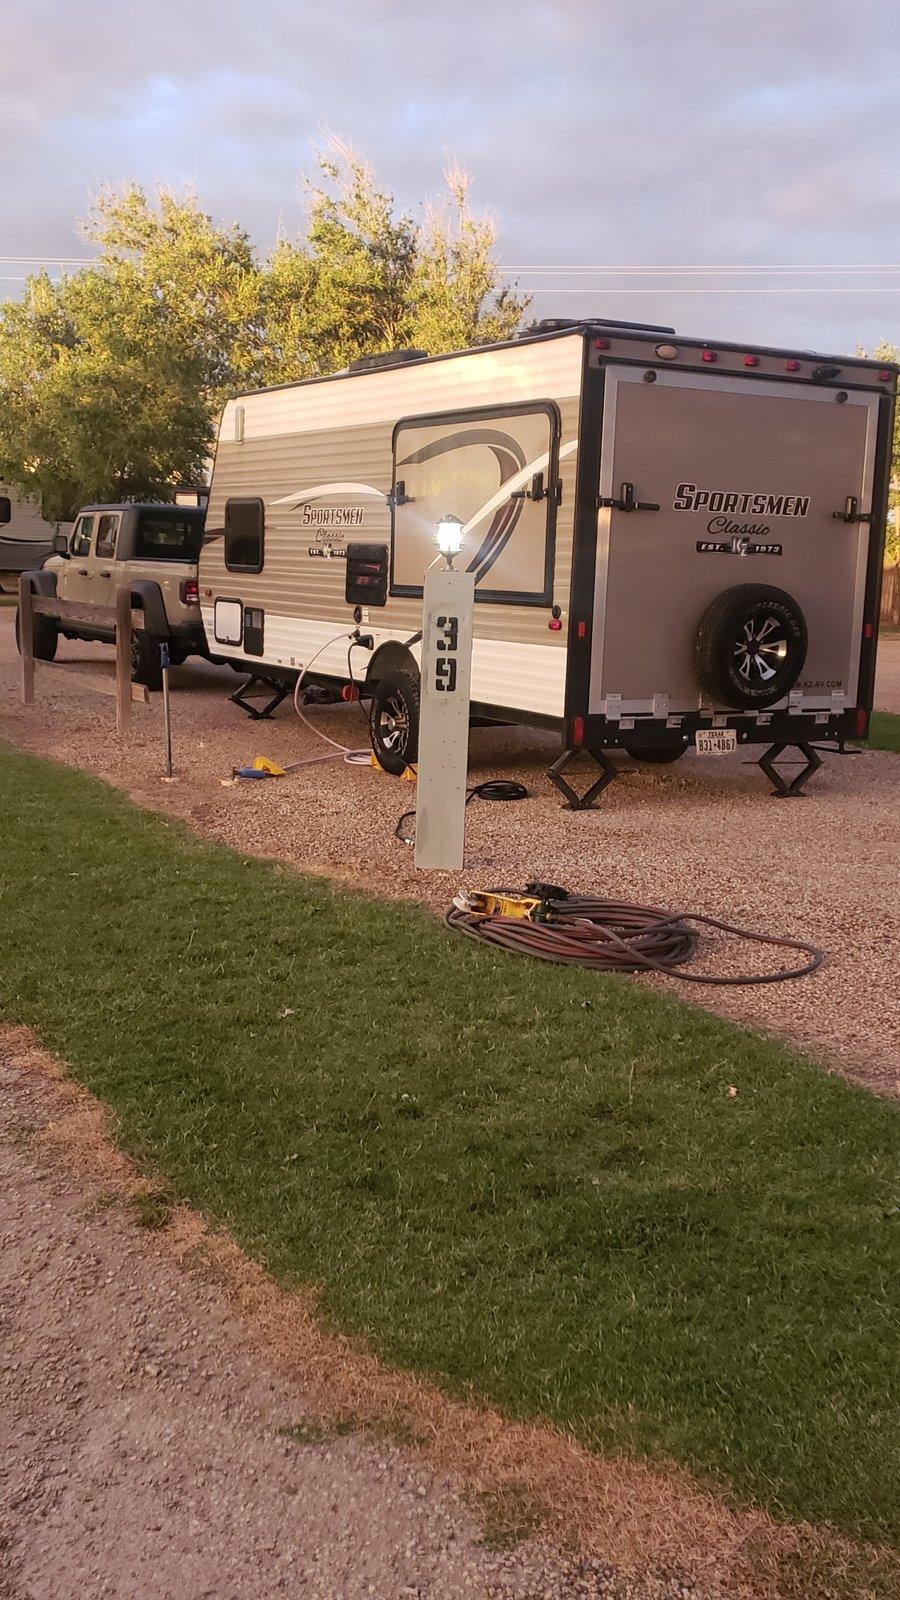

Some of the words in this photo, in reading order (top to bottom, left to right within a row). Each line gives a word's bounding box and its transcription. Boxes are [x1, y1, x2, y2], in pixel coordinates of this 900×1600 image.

[673, 483, 811, 517] SPORTSMEN
[302, 504, 364, 526] SPORTSMEN
[707, 516, 771, 535] Classic
[700, 543, 724, 551] EST.
[754, 545, 780, 553] 1972
[435, 616, 459, 692] 39
